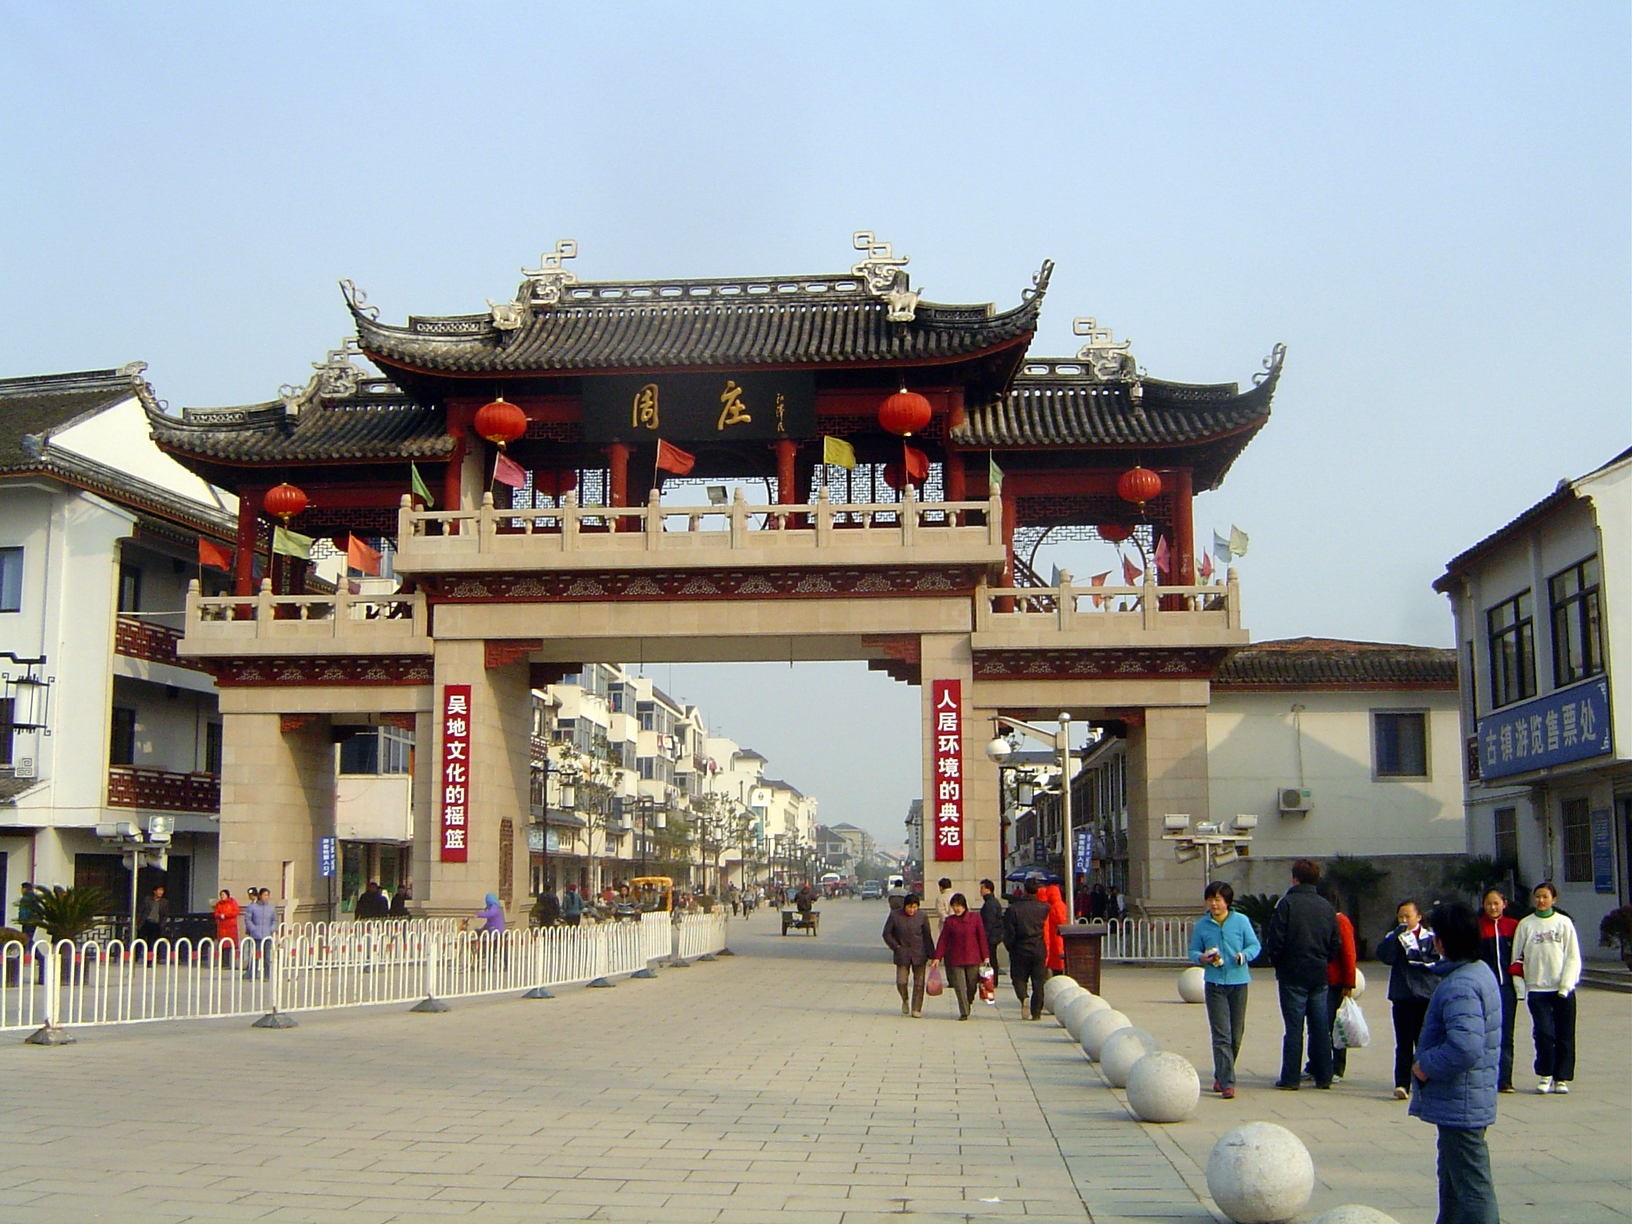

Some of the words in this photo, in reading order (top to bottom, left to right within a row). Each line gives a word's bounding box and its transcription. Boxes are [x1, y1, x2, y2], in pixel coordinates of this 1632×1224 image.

[633, 380, 751, 431] 周庄
[445, 695, 467, 849] 吴地文化的摇篮
[937, 689, 961, 846] 人居环境的典范
[1485, 698, 1596, 766] 古镇游览售票处
